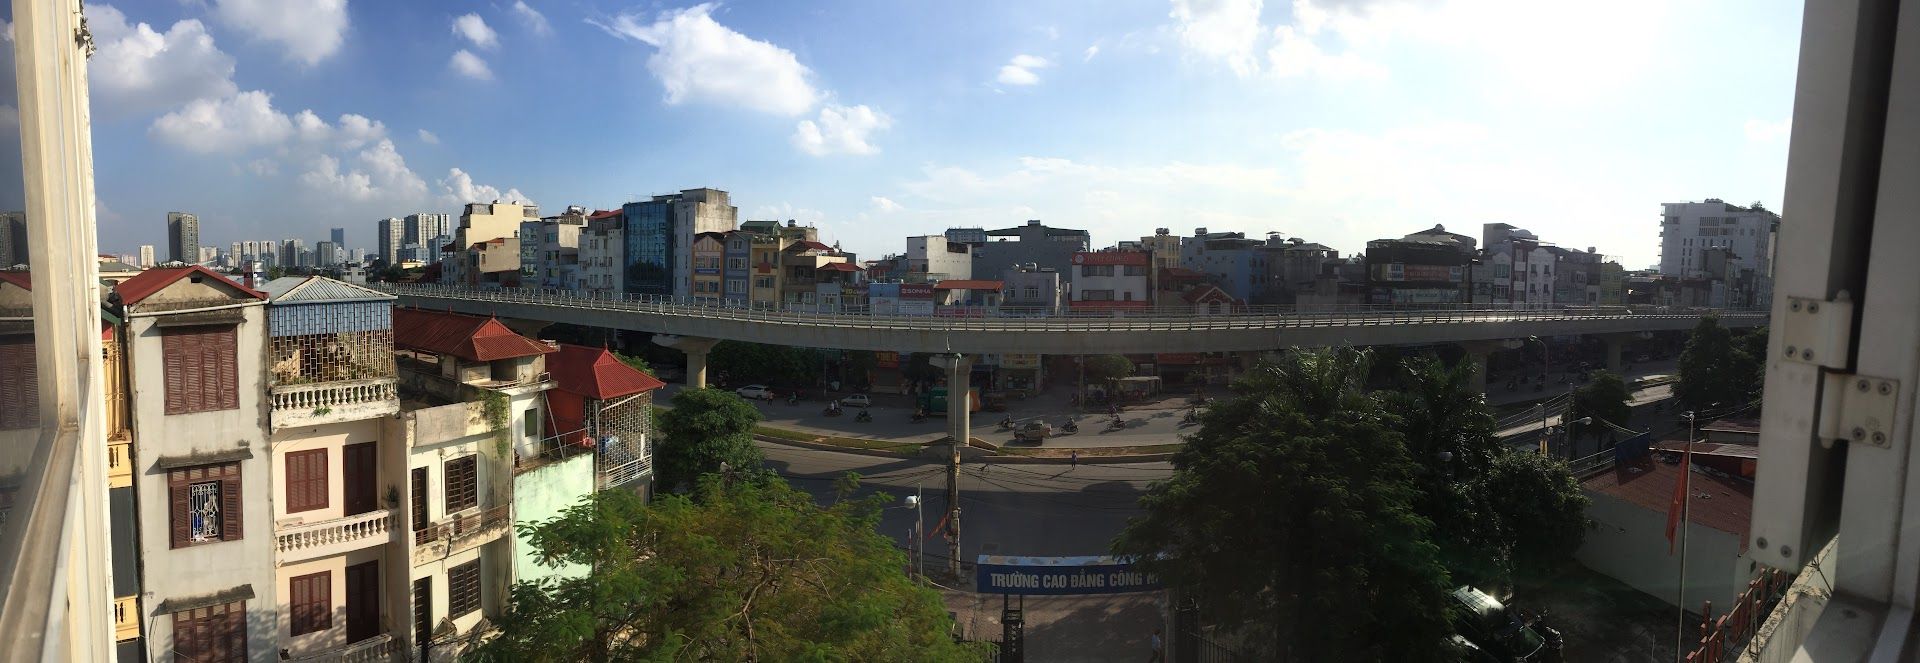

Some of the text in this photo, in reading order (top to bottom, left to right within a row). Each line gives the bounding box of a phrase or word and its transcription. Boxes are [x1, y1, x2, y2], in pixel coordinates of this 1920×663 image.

[990, 571, 1039, 588] TRƯỜNG
[1042, 574, 1067, 588] CAO
[1071, 569, 1105, 588] ĐẲNG
[1109, 572, 1143, 587] CÔNG
